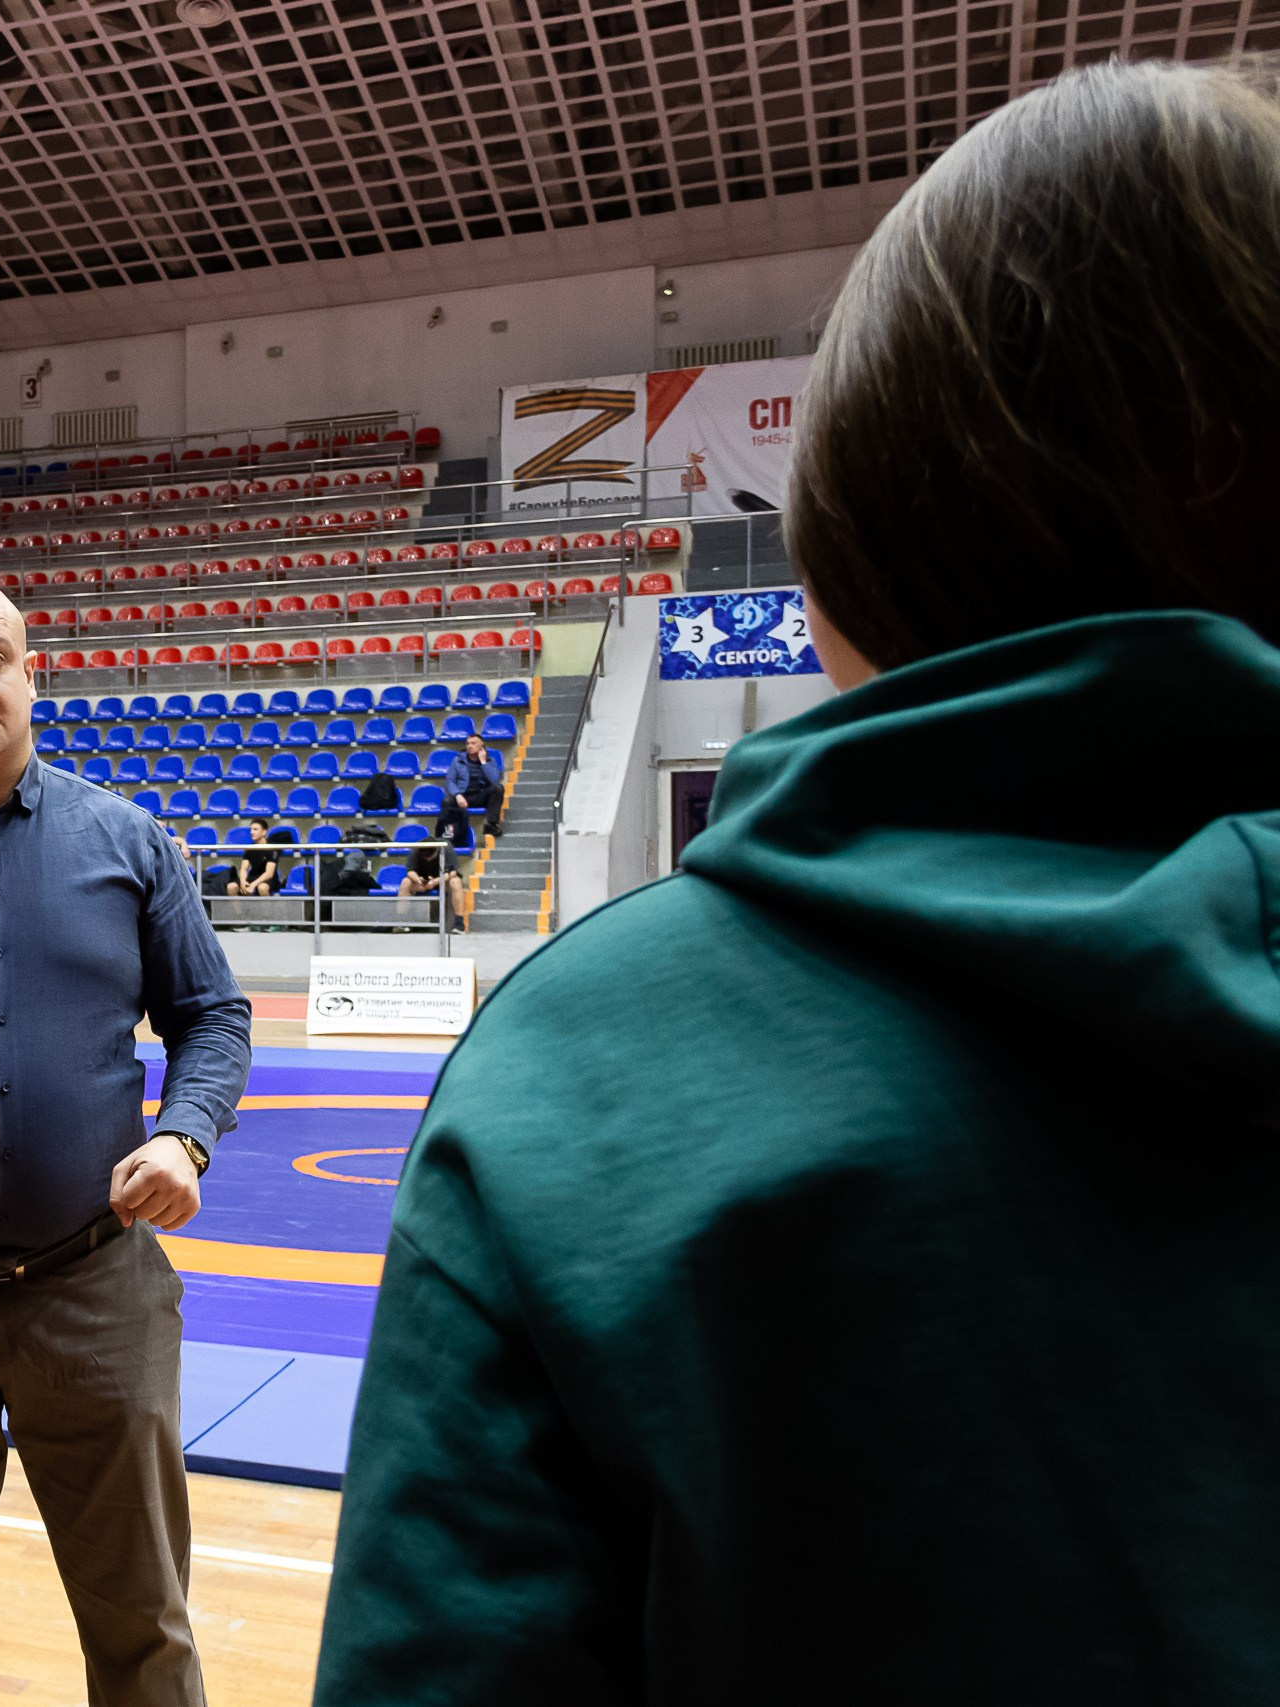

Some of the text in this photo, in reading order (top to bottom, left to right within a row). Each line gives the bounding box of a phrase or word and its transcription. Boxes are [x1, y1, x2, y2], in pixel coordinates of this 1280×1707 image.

[25, 378, 38, 399] 3
[514, 388, 636, 492] Z
[691, 625, 704, 644] 3
[792, 618, 807, 637] 2
[714, 649, 783, 666] СЕКТОР
[317, 971, 462, 988] Фонд Олега Дерипаска
[357, 996, 462, 1009] Развитие медицины
